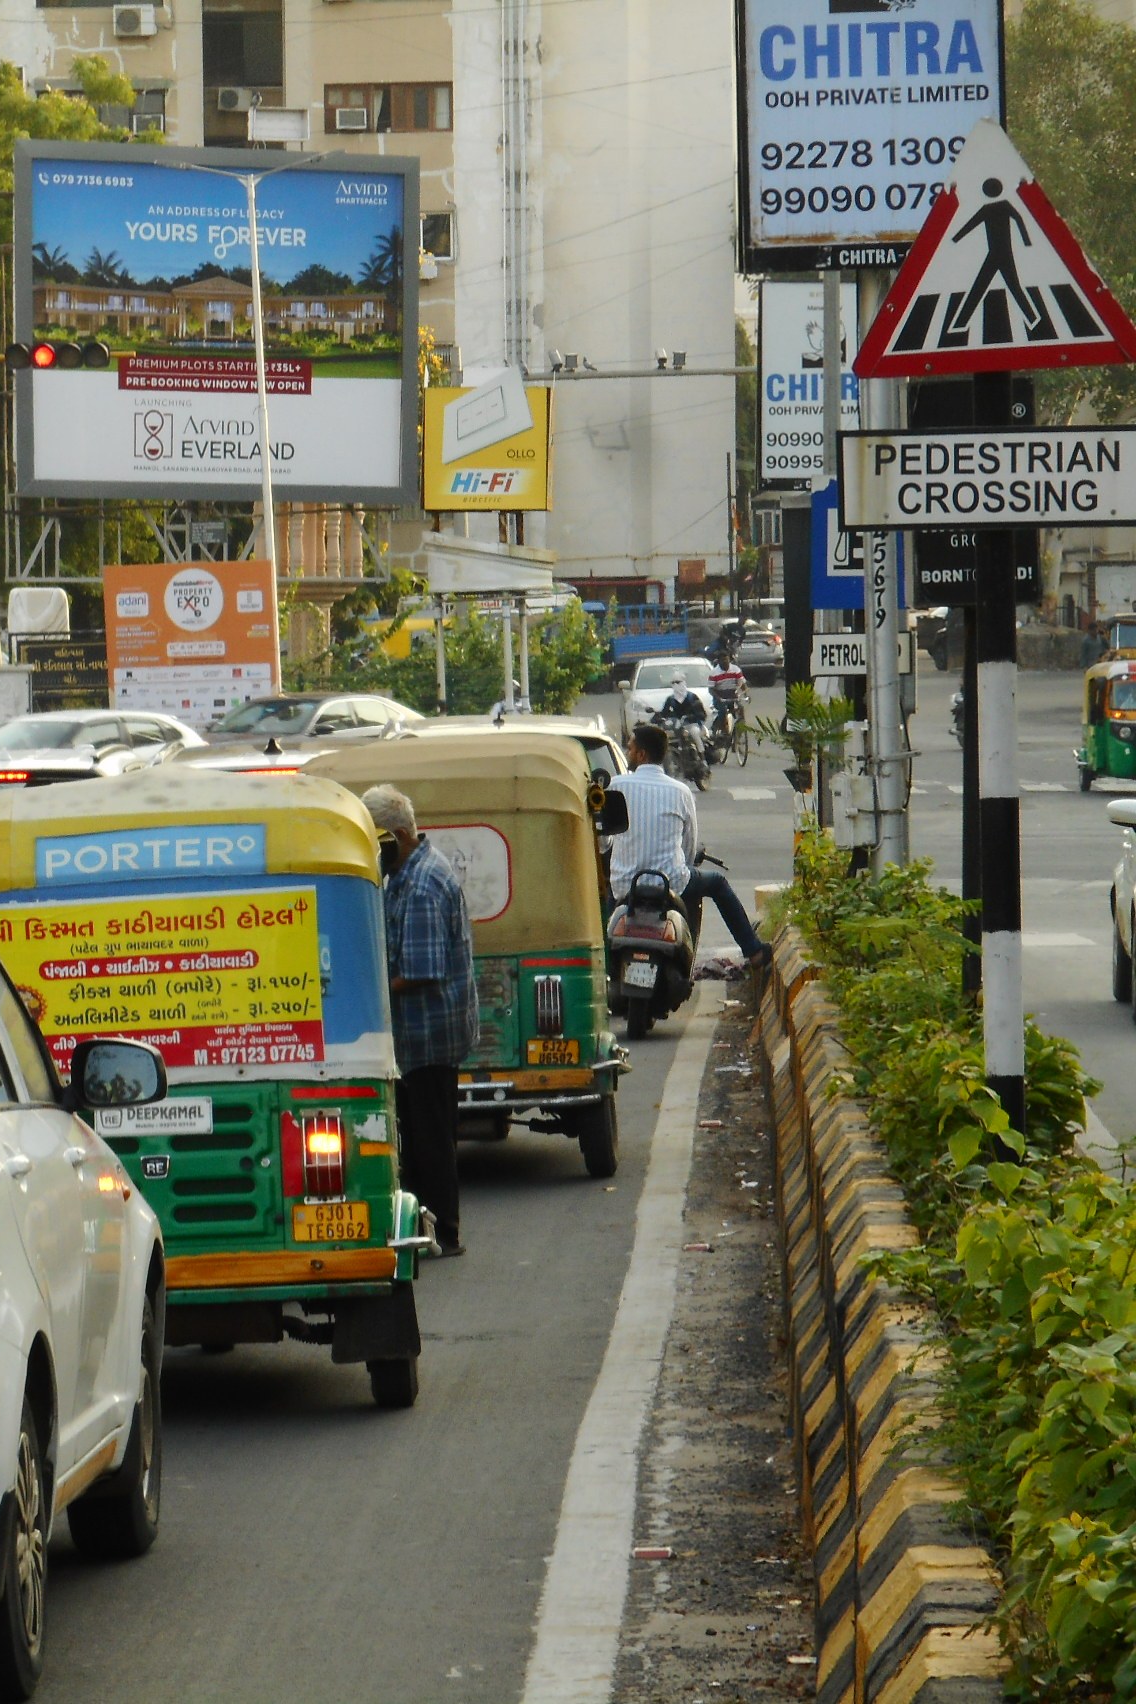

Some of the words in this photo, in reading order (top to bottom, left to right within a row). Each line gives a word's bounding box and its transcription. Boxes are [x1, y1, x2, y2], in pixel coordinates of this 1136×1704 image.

[759, 19, 984, 82] CHITRA
[765, 90, 809, 108] OOH
[816, 87, 902, 106] PRIVATE
[908, 84, 990, 104] LIMITED
[761, 139, 873, 170] 92278
[882, 136, 966, 166] 1309
[53, 174, 77, 185] 079
[761, 184, 876, 215] 99090
[148, 205, 165, 216] AN
[166, 206, 221, 217] ADDRESS
[222, 208, 238, 218] OF
[125, 221, 198, 243] YOURS
[129, 358, 179, 370] PREMIUM
[180, 359, 214, 371] PLOTS
[126, 377, 200, 389] PRE-BOOKING
[202, 379, 249, 390] WINDOW
[250, 381, 275, 391] NW
[277, 381, 306, 391] OPEN
[134, 398, 193, 408] LAUNCHING
[768, 406, 792, 416] OOH
[766, 431, 824, 447] 90990
[507, 448, 535, 459] OLLO
[874, 440, 1121, 477] PEDESTRIAN
[765, 455, 824, 469] 90995
[898, 479, 1099, 515] CROSSING
[174, 587, 213, 596] PROPERTY
[118, 595, 147, 606] adani
[177, 595, 210, 610] EXPO
[820, 643, 866, 667] PETROL
[45, 836, 234, 879] PORTER
[25, 917, 95, 941] કિસ્મત
[106, 906, 225, 936] કાઠીયાવાડી
[237, 903, 294, 929] હોટલ
[44, 961, 87, 978] પંજાબી
[179, 951, 254, 971] કાઠીયાવાડી
[221, 1046, 266, 1064] 97123
[270, 1043, 315, 1061] 07745
[127, 1105, 205, 1121] DEEPKAMAL
[146, 1162, 164, 1174] RE
[316, 1204, 354, 1222] GJ01
